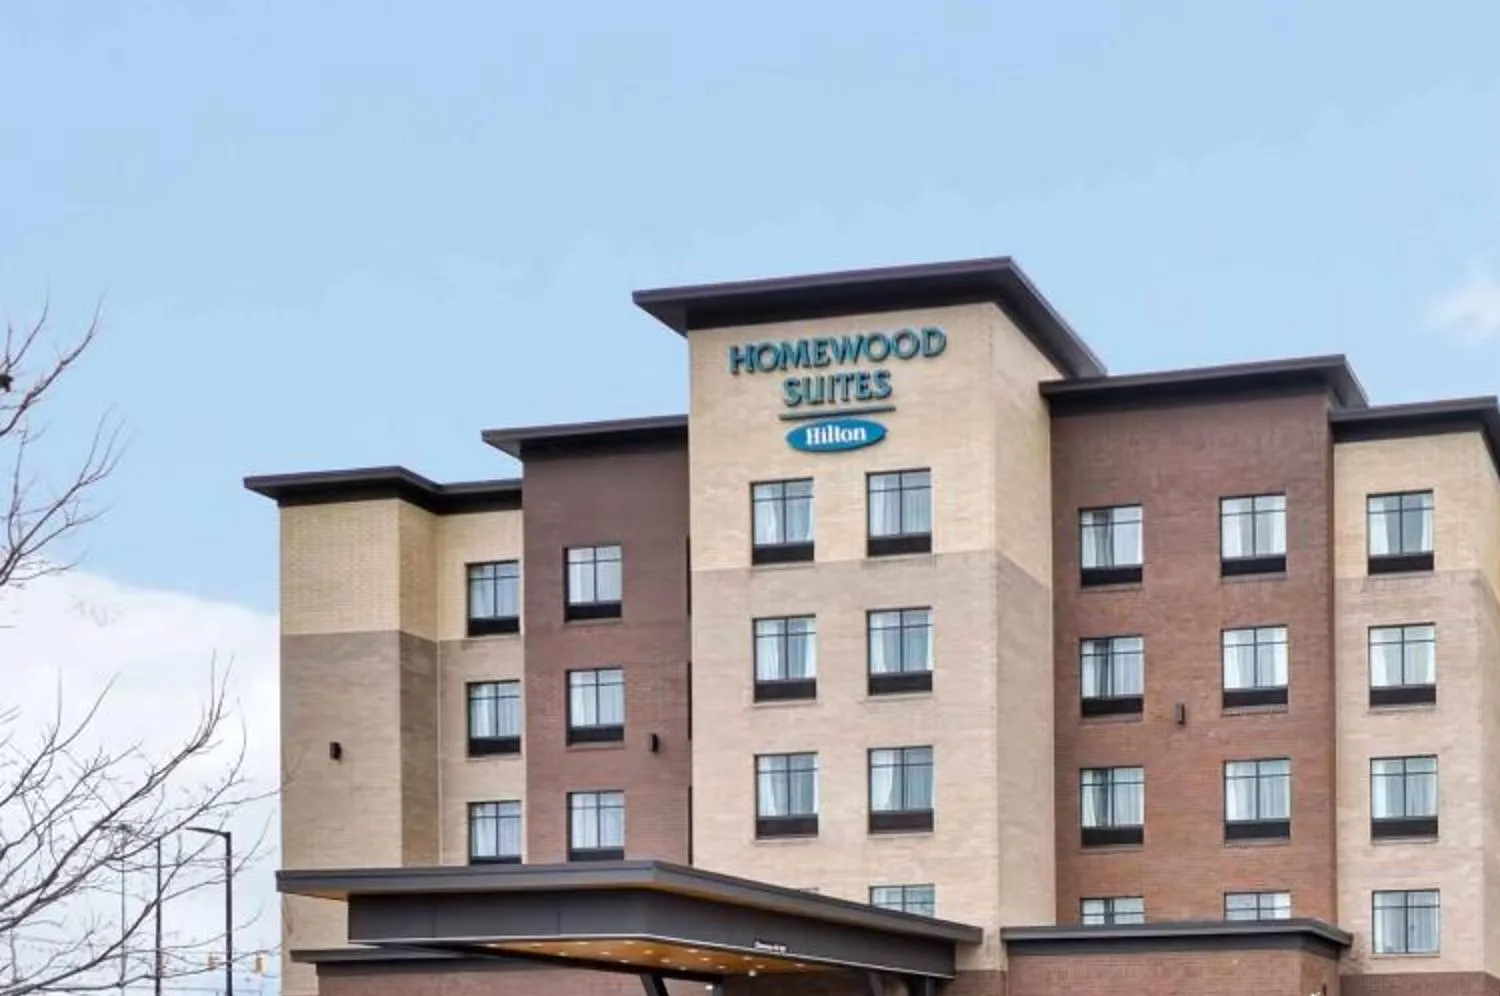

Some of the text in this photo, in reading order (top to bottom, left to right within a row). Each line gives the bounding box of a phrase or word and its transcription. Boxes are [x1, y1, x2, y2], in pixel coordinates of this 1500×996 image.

[730, 326, 947, 375] HOMEWOOD
[783, 370, 893, 407] SUITES
[805, 425, 867, 446] Hilton
